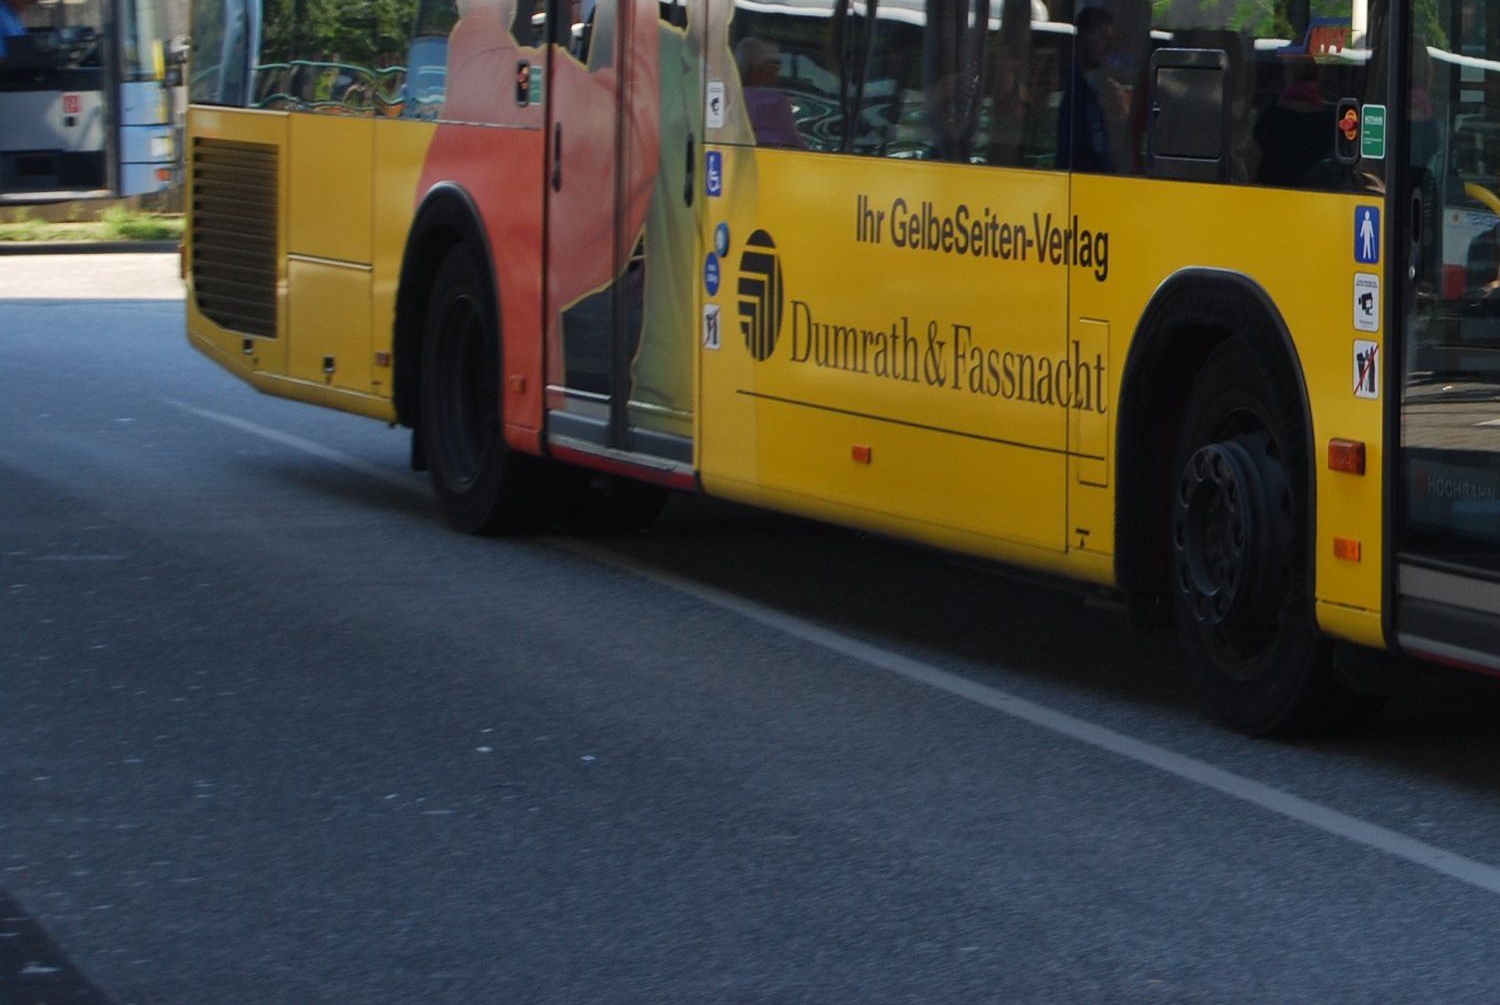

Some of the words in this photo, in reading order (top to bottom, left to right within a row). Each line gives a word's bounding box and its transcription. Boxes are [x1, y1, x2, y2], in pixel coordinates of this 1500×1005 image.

[856, 194, 885, 245] Ihr
[890, 197, 1109, 283] GelbeSeiten-Verlag
[1427, 476, 1497, 502] HOCHBAHN
